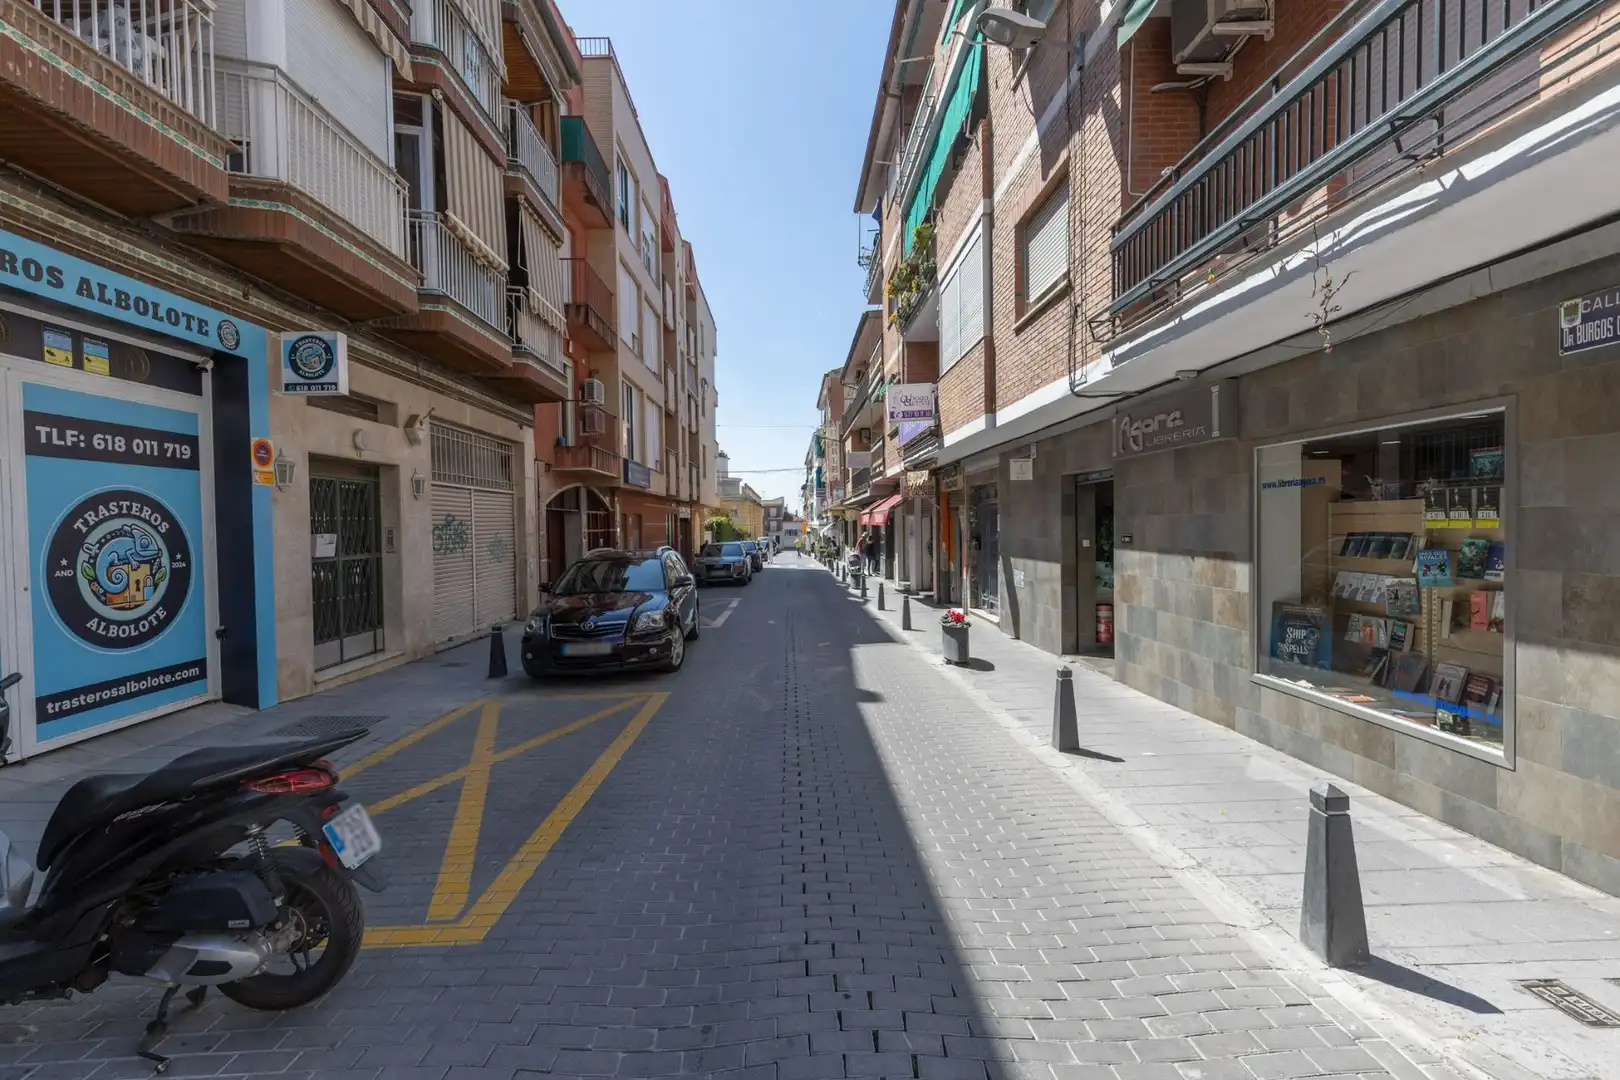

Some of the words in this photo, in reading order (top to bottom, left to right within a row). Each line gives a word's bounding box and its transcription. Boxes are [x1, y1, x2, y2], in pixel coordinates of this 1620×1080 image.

[76, 276, 209, 337] ALBOLOTE
[1576, 316, 1614, 345] BURGOS
[35, 425, 86, 448] TLF:
[92, 433, 126, 452] 618
[132, 438, 159, 457] 011
[163, 442, 192, 460] 719
[73, 501, 170, 535] TRASTEROS
[54, 569, 74, 578] AND
[85, 606, 167, 638] ALBOLOTE
[46, 666, 200, 714] trasterosalbolote.com
